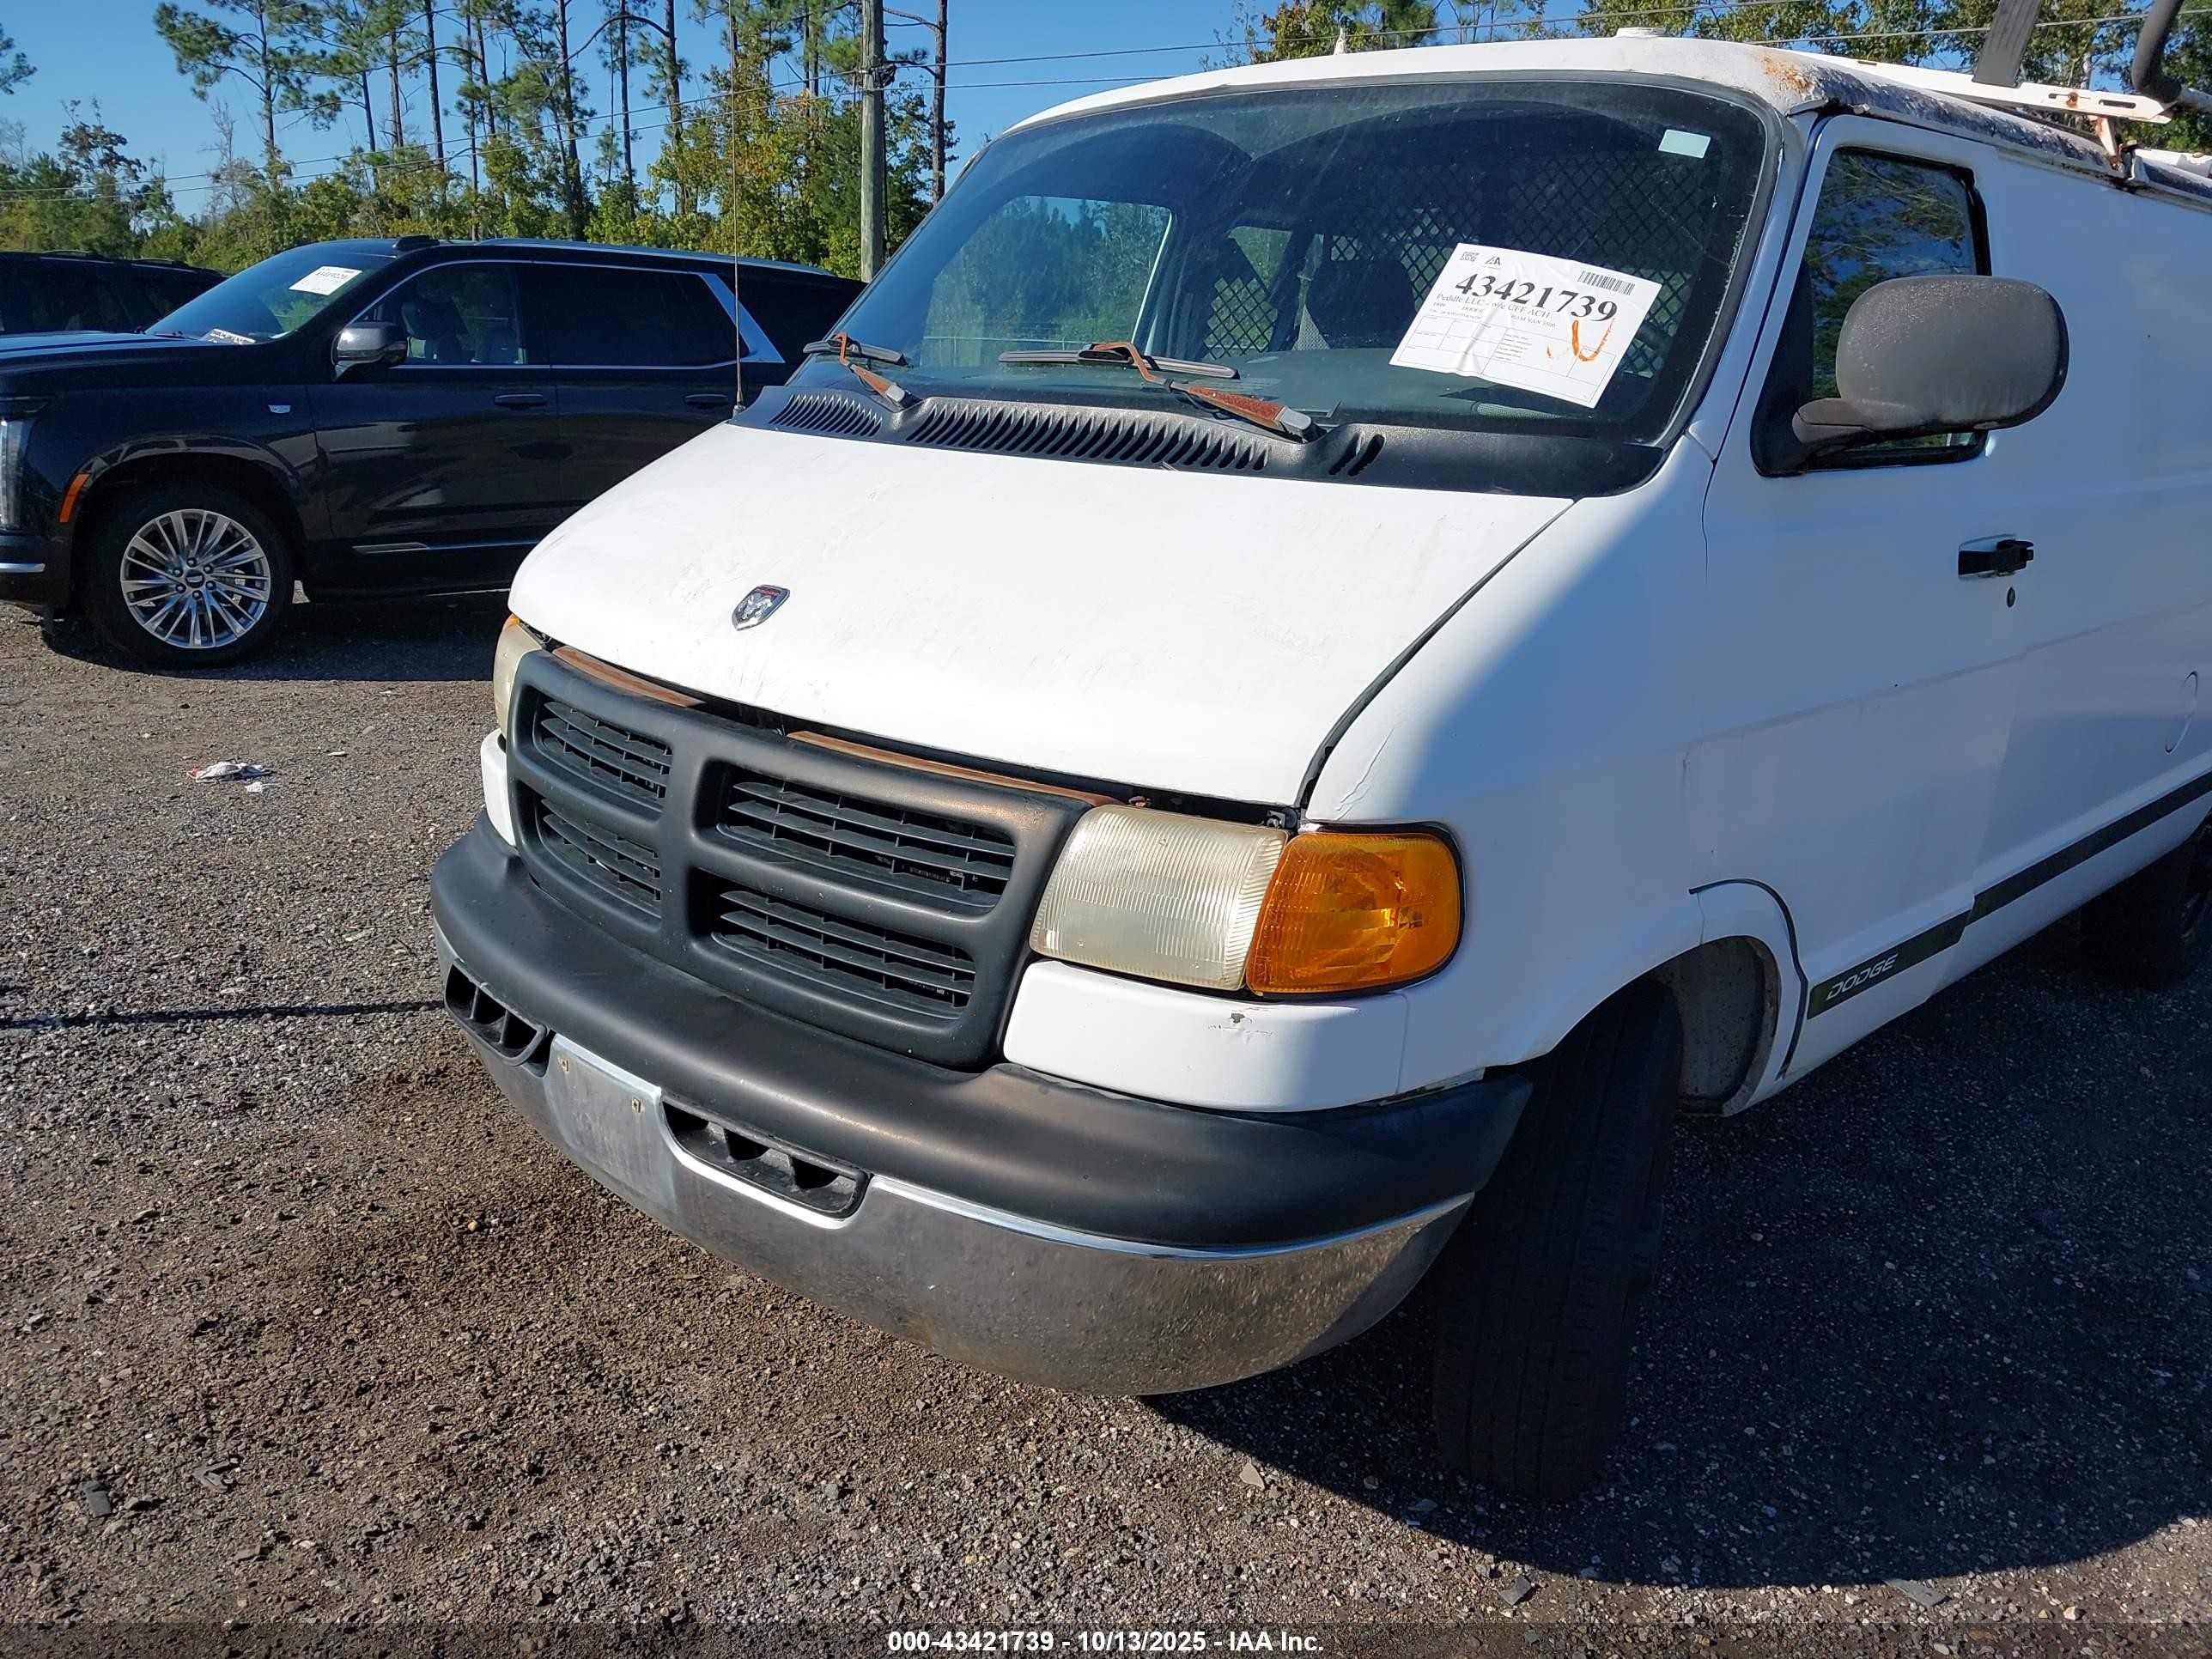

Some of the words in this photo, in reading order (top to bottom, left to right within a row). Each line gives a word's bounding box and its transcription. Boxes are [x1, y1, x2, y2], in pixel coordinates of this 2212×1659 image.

[1437, 293, 1463, 303] Peddle
[1465, 296, 1486, 306] LLC
[1455, 273, 1618, 322] 43421739
[1826, 953, 1899, 1000] DODGE
